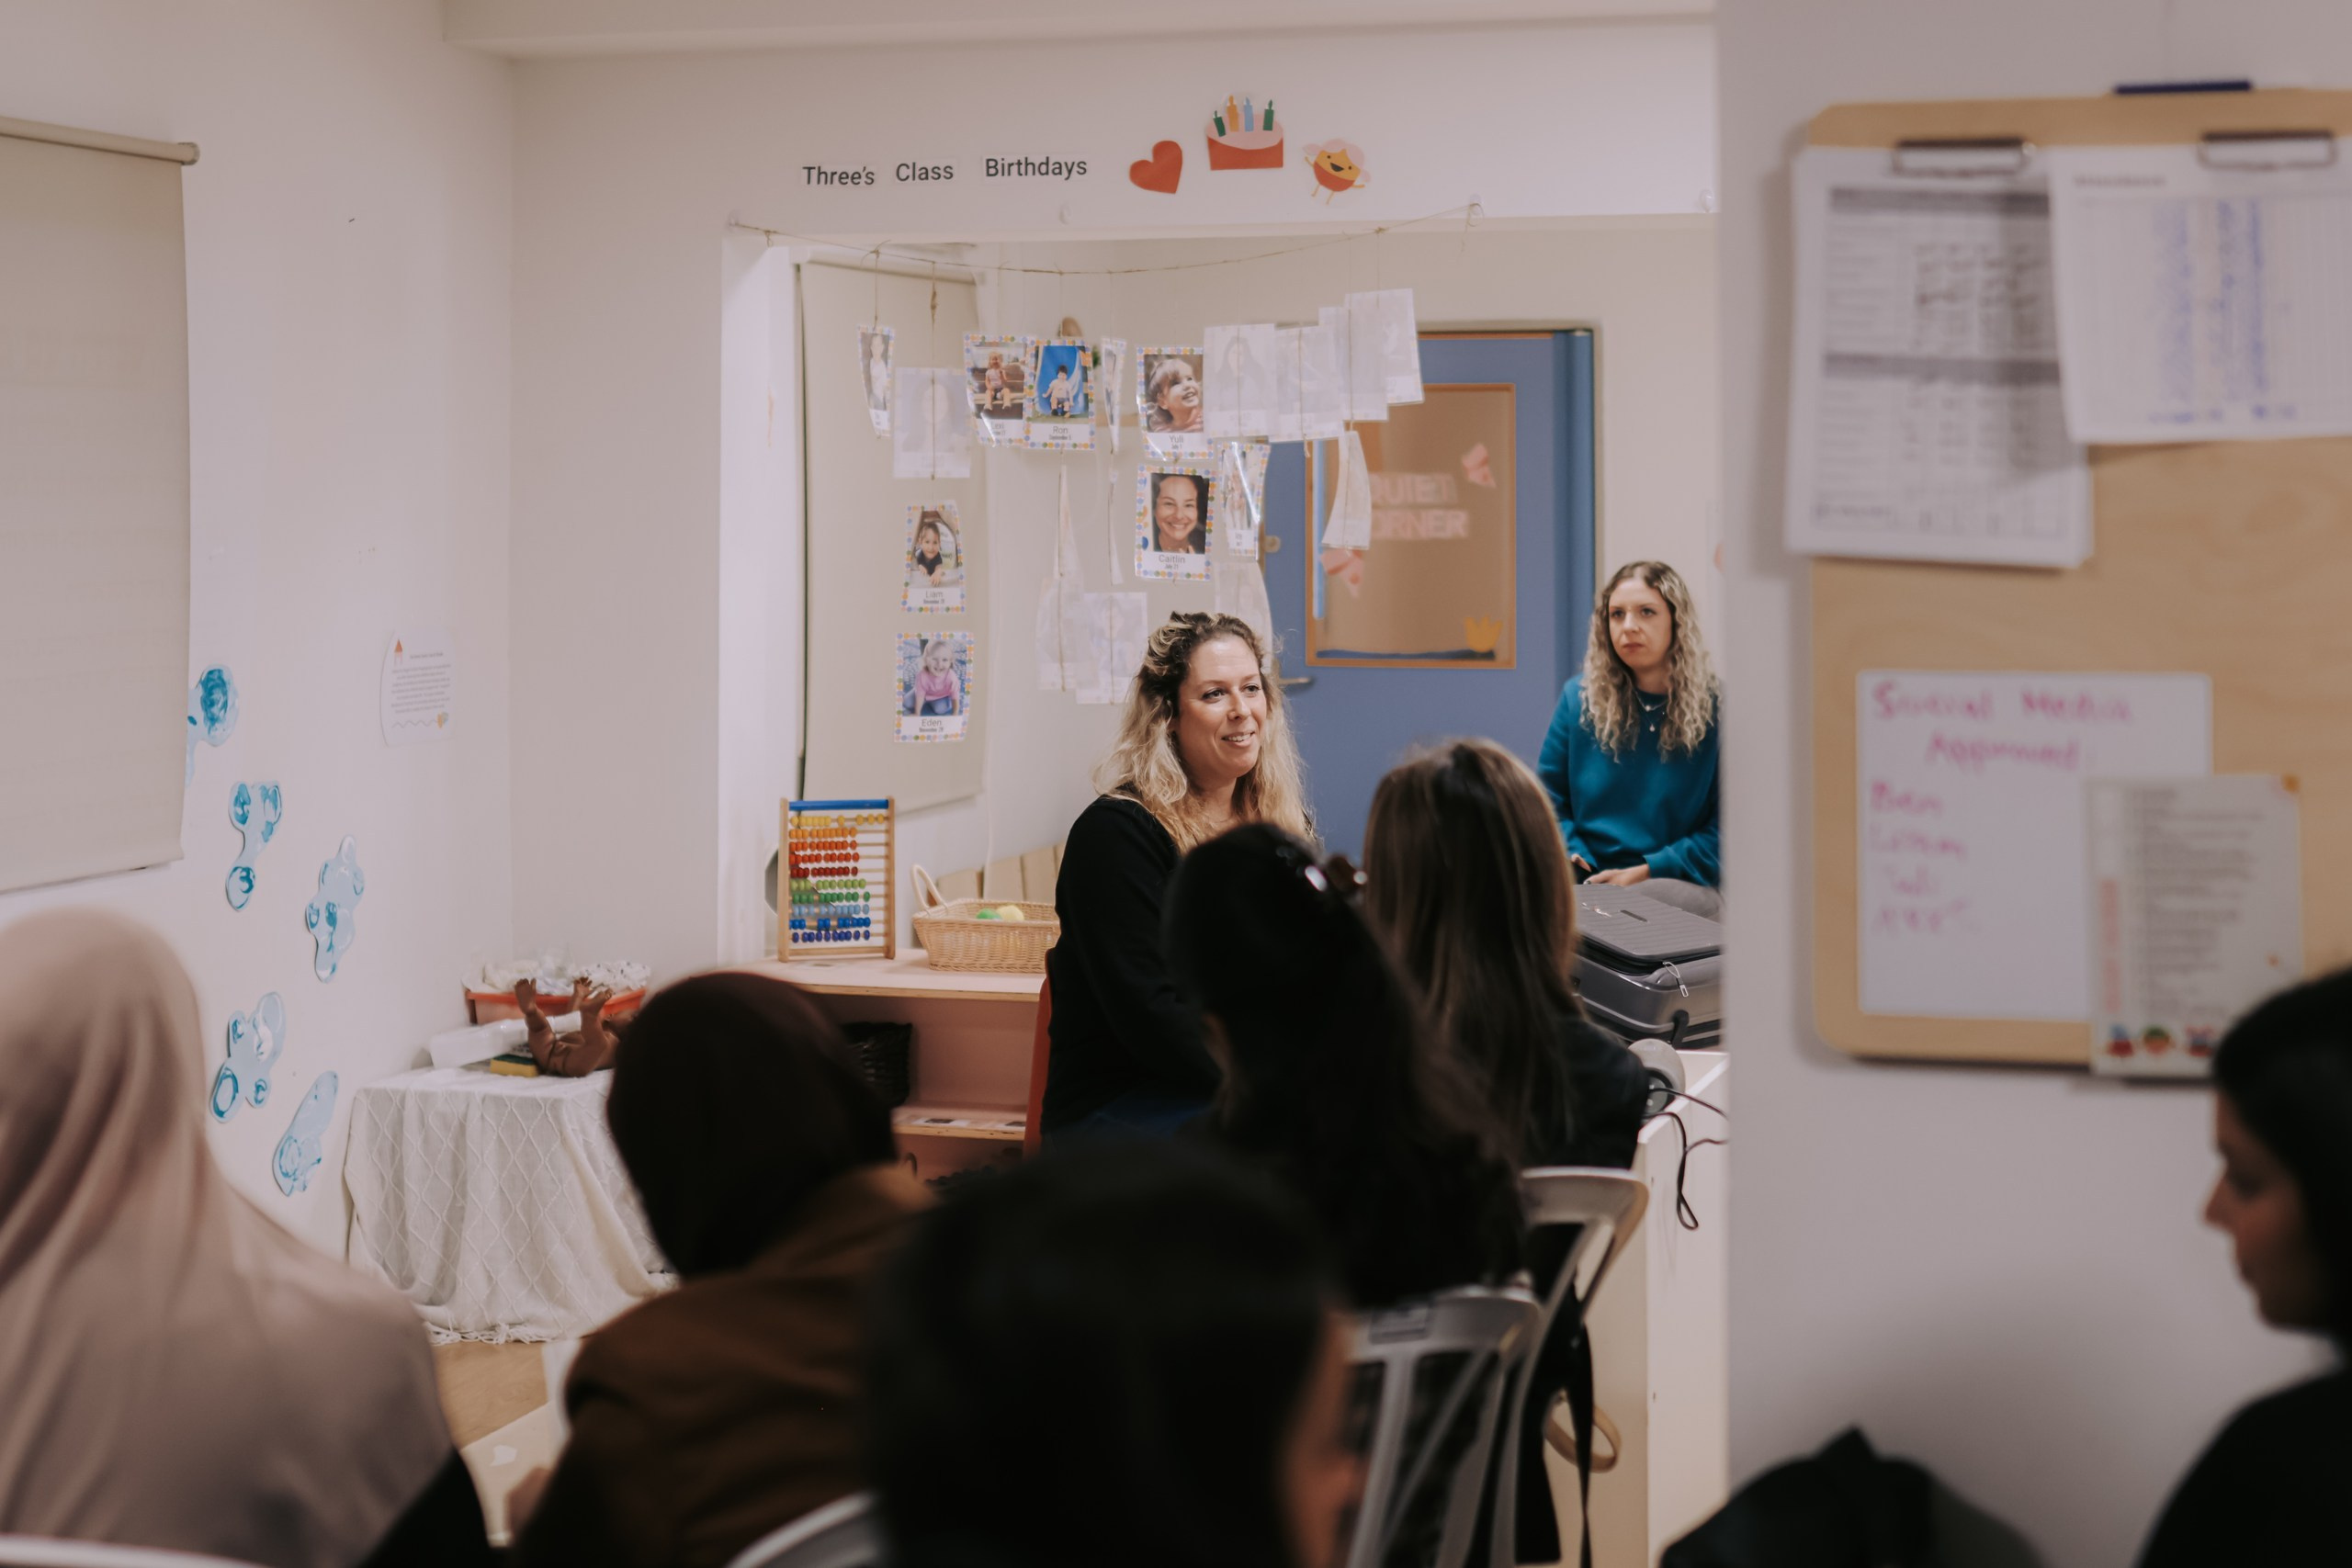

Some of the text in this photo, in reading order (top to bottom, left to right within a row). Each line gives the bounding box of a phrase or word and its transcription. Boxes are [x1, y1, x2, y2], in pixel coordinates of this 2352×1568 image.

[895, 162, 955, 182] Class
[985, 155, 1088, 181] Birthdays
[1052, 425, 1069, 434] Ron
[1169, 434, 1184, 444] Yuli
[1372, 510, 1469, 540] ORNER
[1158, 554, 1186, 564] Caitlin
[925, 590, 944, 599] Liam
[921, 717, 943, 728] Eden
